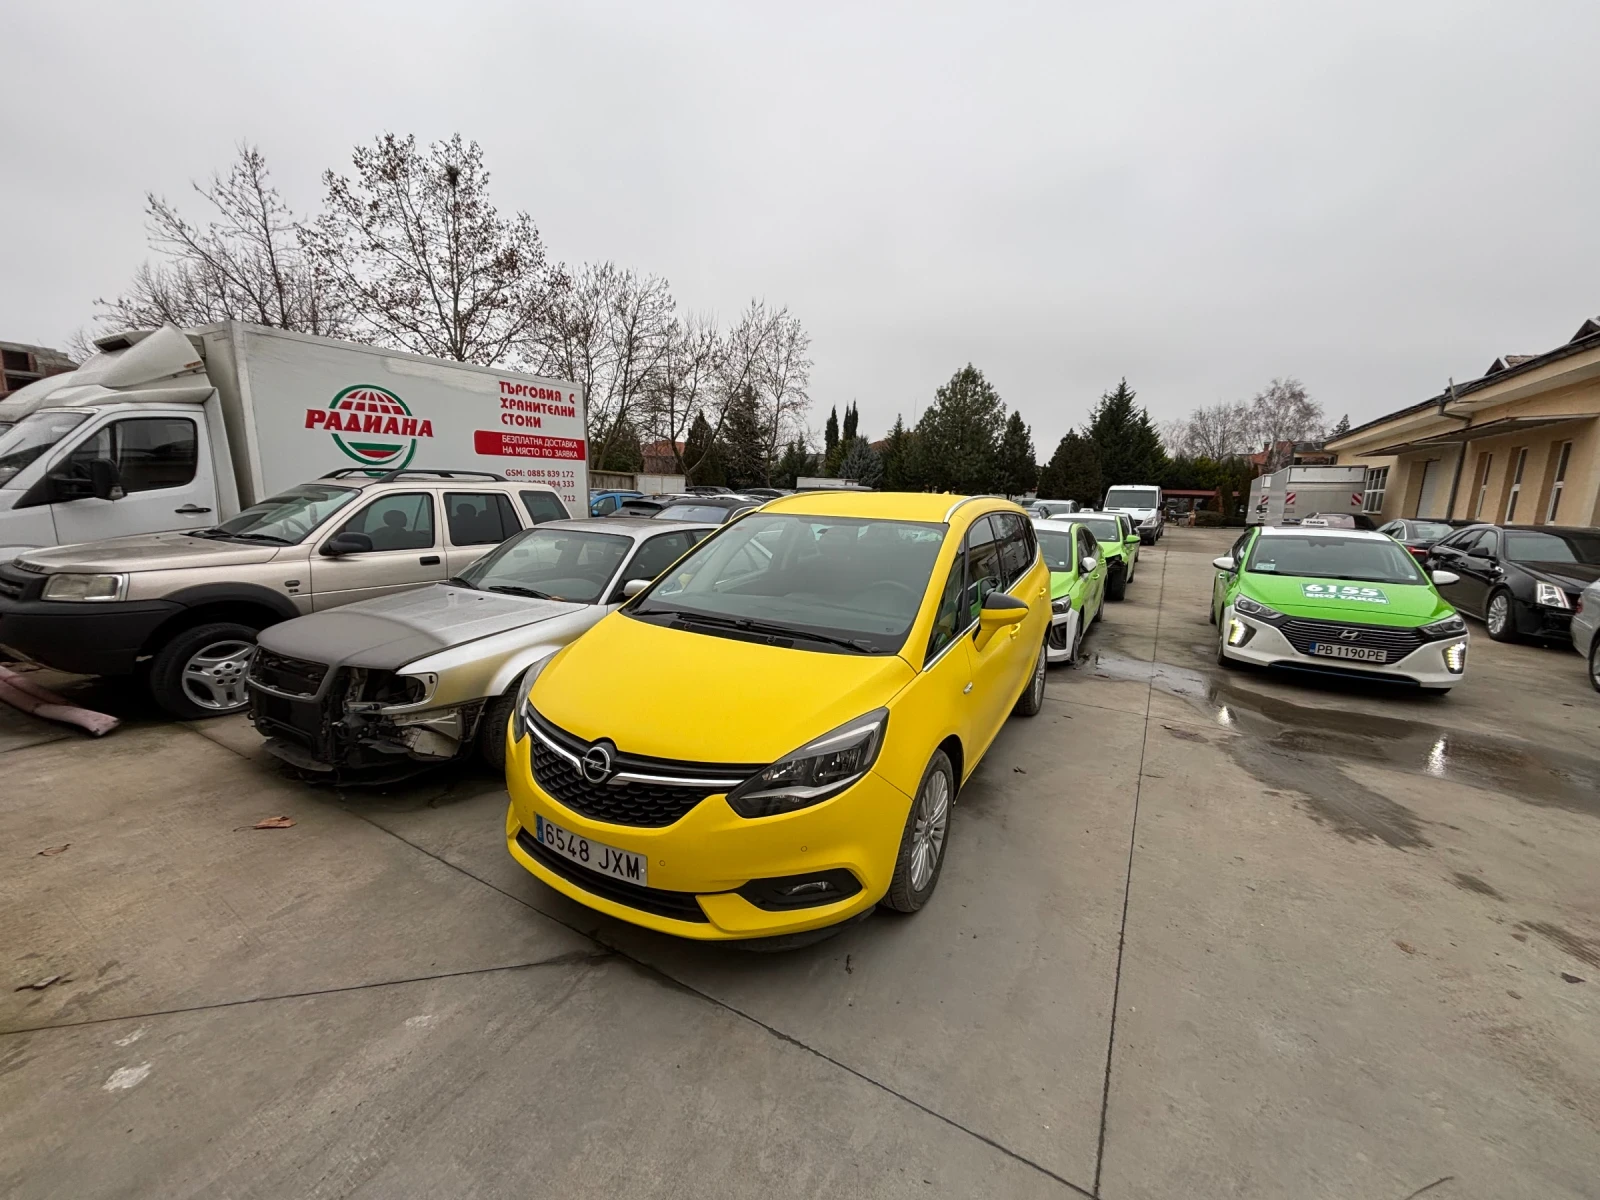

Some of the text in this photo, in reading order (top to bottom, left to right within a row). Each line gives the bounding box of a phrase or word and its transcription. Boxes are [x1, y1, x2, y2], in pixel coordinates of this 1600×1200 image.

[499, 381, 562, 402] ТЪРГОВИЯ
[500, 397, 575, 418] ХРАНИТЕЛНИ
[305, 409, 434, 437] РАДИАНА
[501, 413, 541, 428] СТОКИ
[502, 434, 578, 449] БЕЗПЛАТНА ДОСТАВКА
[502, 446, 513, 454] НА
[516, 447, 540, 456] МЯСТО
[554, 449, 578, 458] ЗАЯВКА
[505, 469, 574, 478] GSM: 0885 839 172
[562, 480, 575, 488] 333
[563, 494, 576, 502] 712
[1305, 584, 1378, 596] 6155
[1317, 644, 1385, 661] PB 1190 PE
[545, 823, 640, 880] 6548 JXM
